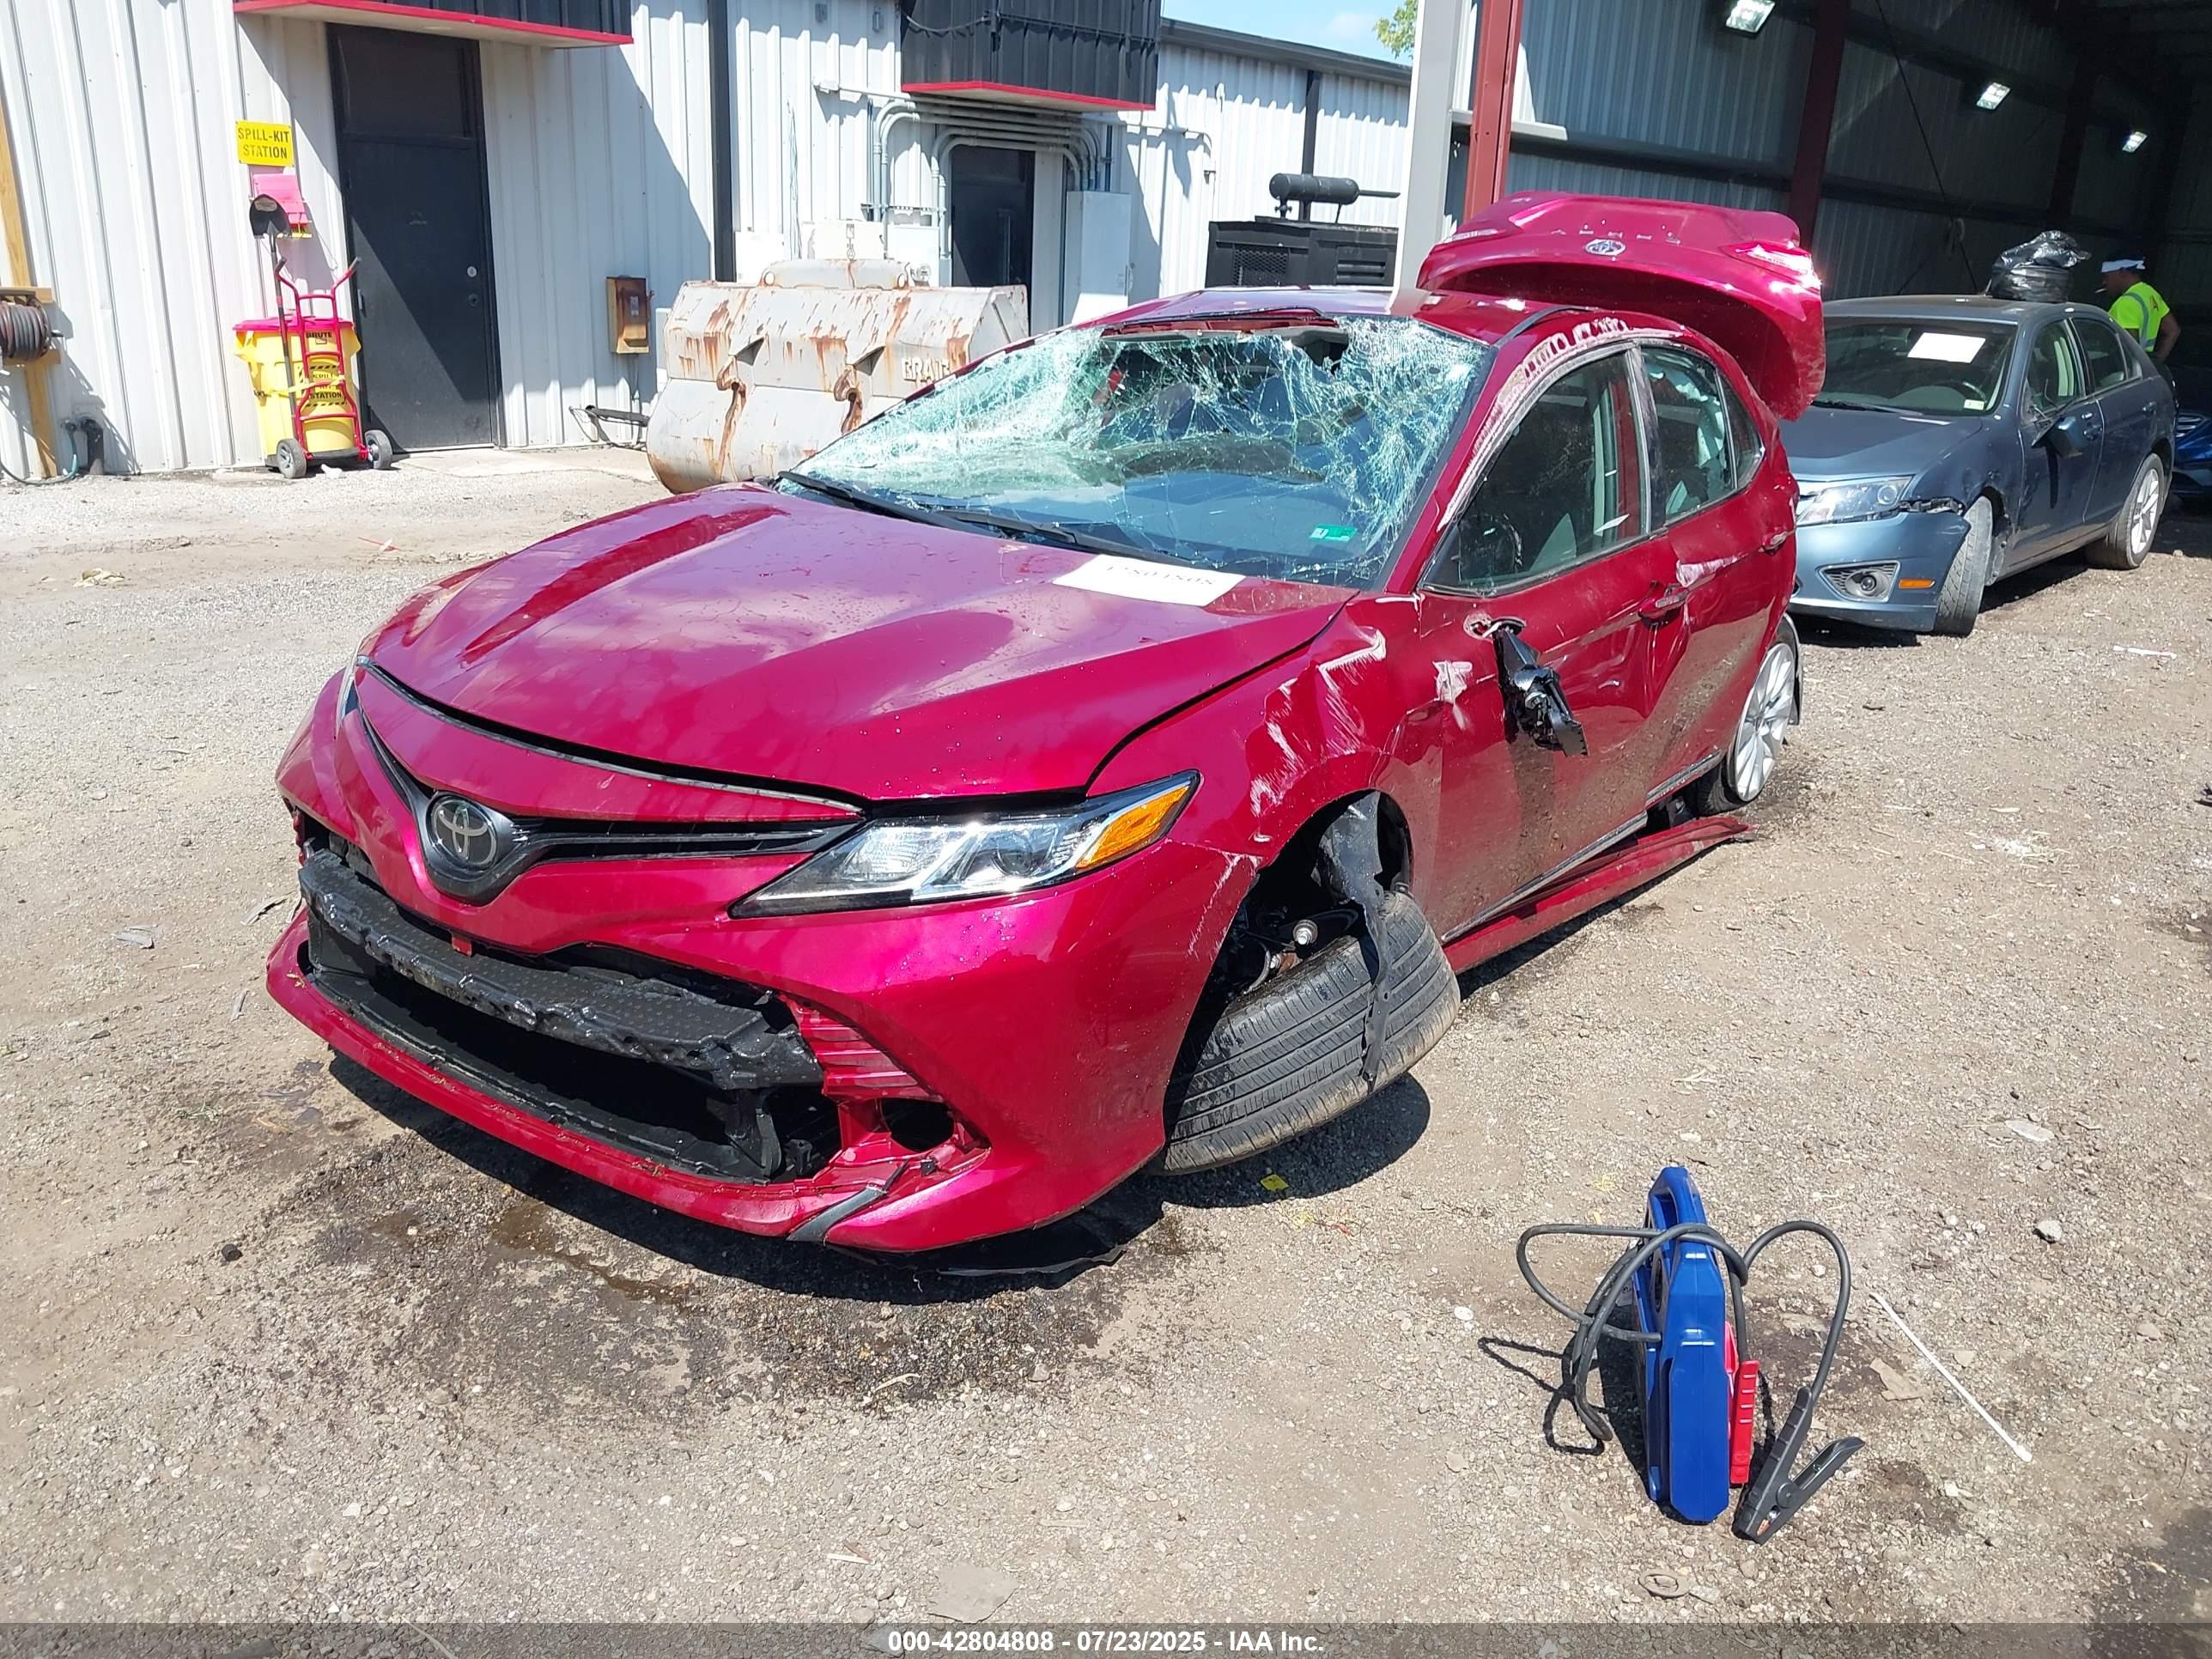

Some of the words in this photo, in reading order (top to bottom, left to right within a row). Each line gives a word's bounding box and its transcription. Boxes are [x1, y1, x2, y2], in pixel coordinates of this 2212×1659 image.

[238, 127, 289, 143] SPILL-KIT
[243, 144, 288, 159] STATION
[310, 391, 342, 399] STATION
